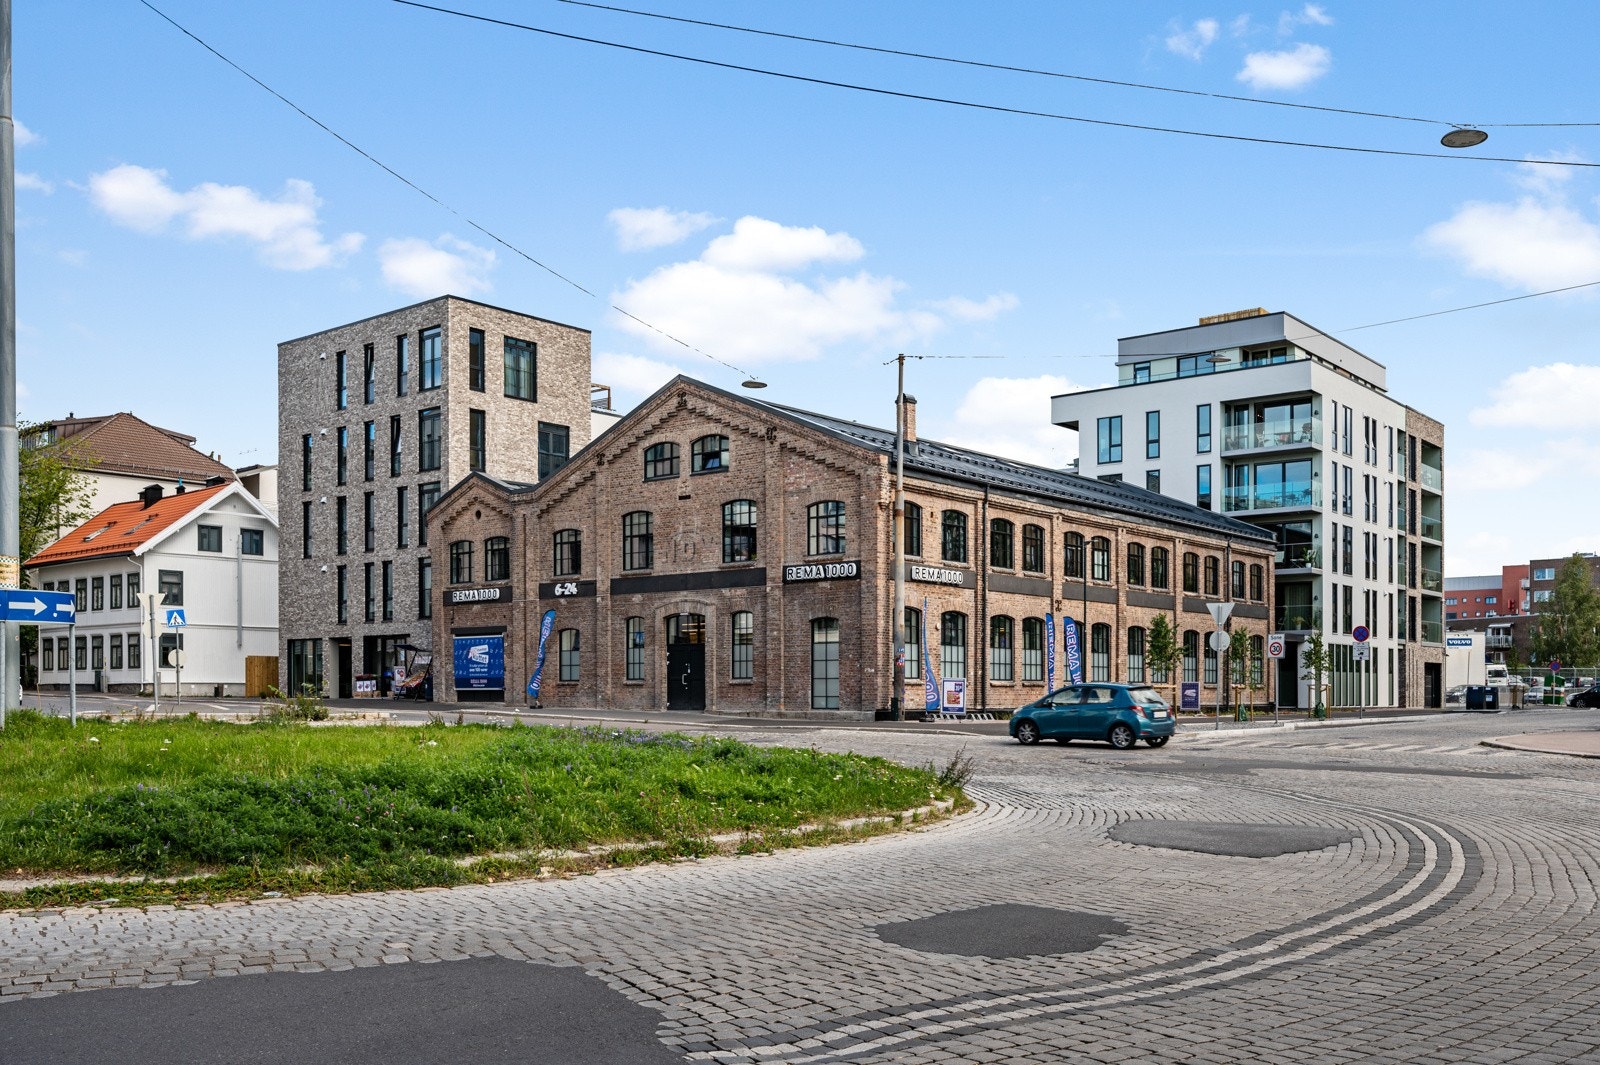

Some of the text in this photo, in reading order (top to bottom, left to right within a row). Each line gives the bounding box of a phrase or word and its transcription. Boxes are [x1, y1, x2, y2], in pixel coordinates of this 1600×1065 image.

[787, 563, 856, 580] REMA 1000
[913, 566, 964, 584] REMA 1000
[453, 588, 499, 602] REMA 1000
[555, 582, 577, 595] 6-24
[1066, 623, 1080, 670] REMA
